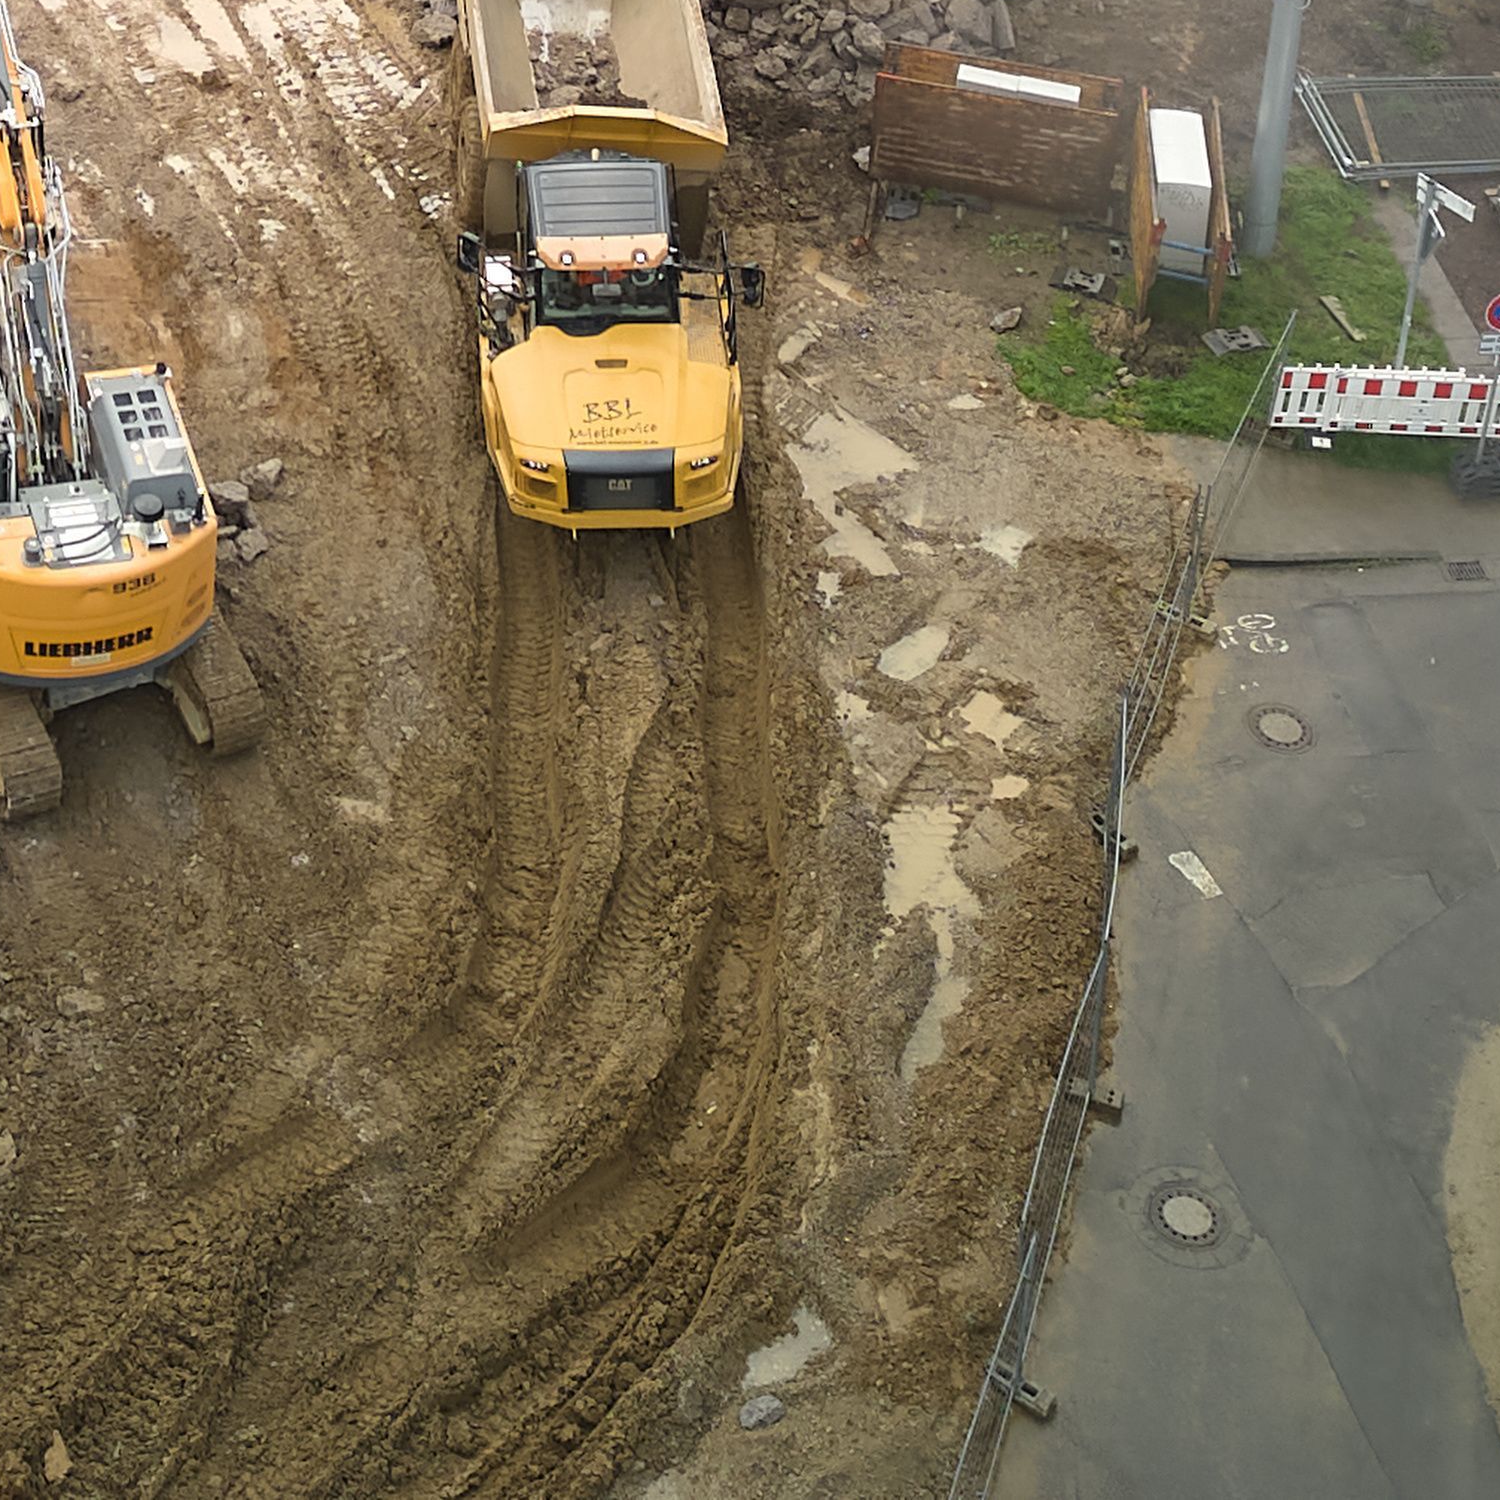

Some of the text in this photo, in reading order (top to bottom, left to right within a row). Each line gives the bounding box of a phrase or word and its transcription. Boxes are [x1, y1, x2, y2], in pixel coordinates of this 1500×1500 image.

[583, 397, 642, 423] BBL
[608, 479, 632, 491] CAT
[24, 626, 154, 658] LIEBHERR
